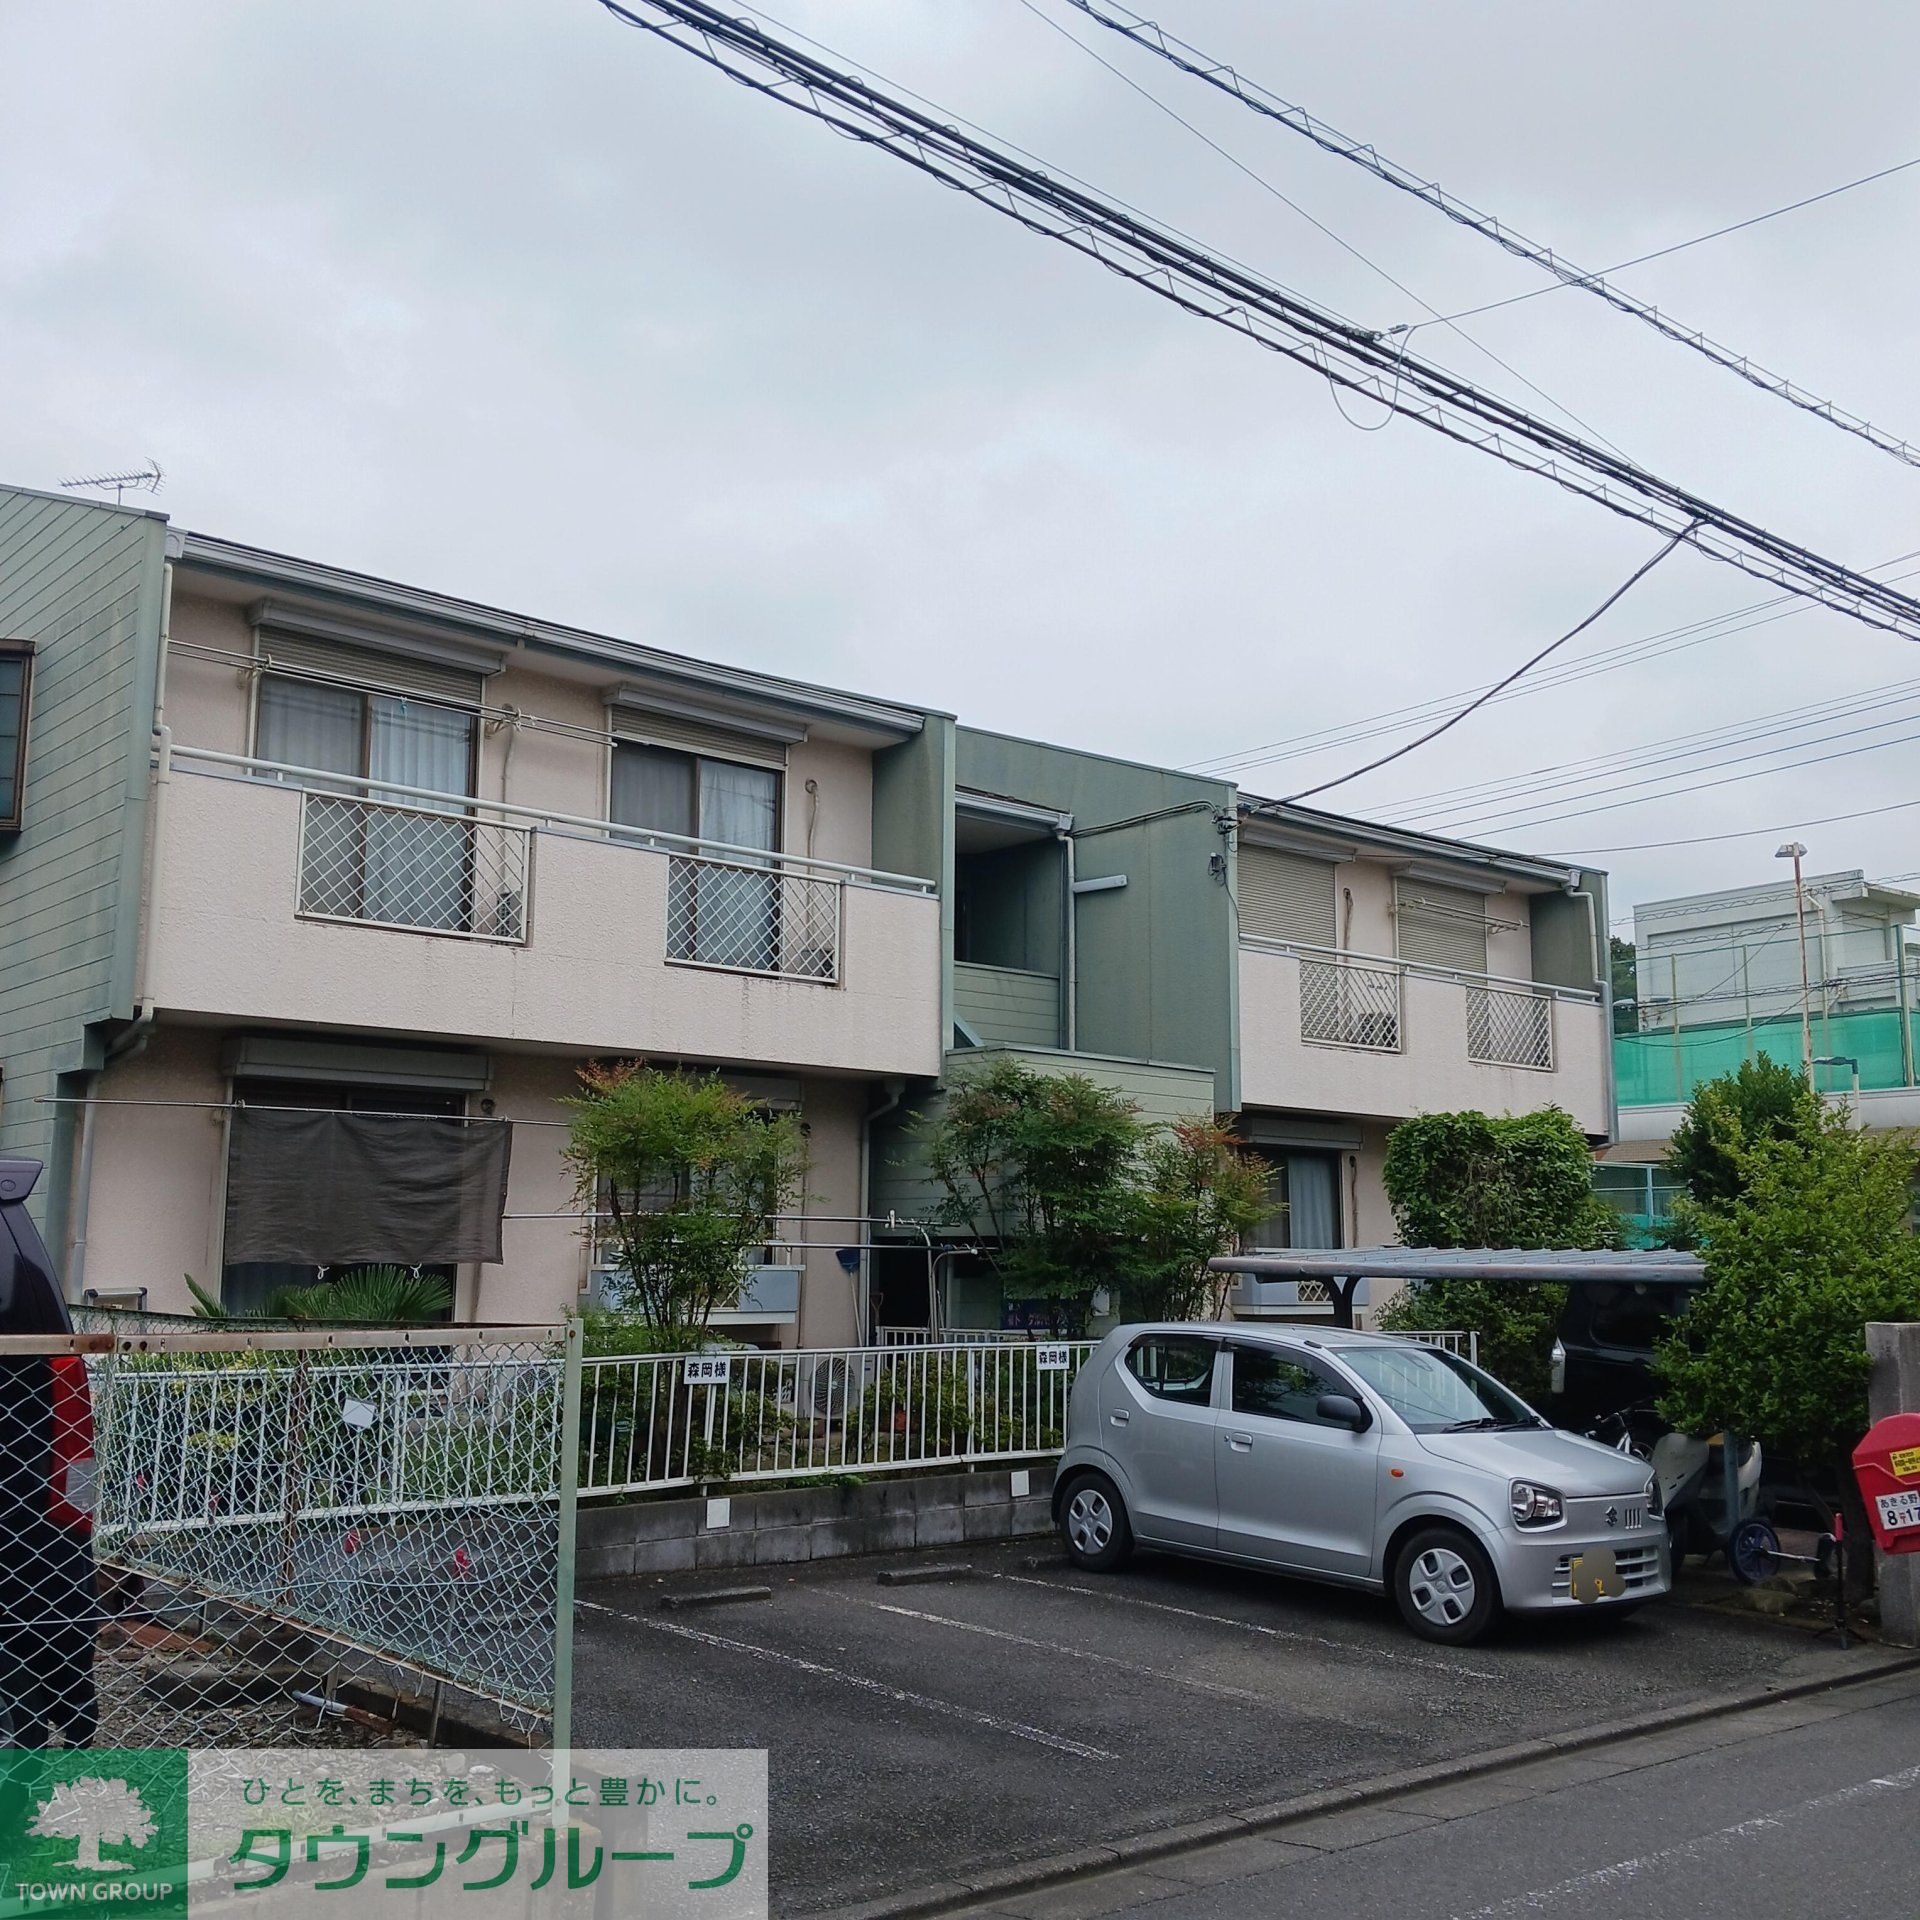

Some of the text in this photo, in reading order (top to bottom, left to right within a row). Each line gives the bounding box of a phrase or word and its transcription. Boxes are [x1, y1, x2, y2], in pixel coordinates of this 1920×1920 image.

[1039, 1350, 1067, 1365] 森岡様
[687, 1361, 727, 1379] 森岡様
[1880, 1493, 1918, 1509] あきる野
